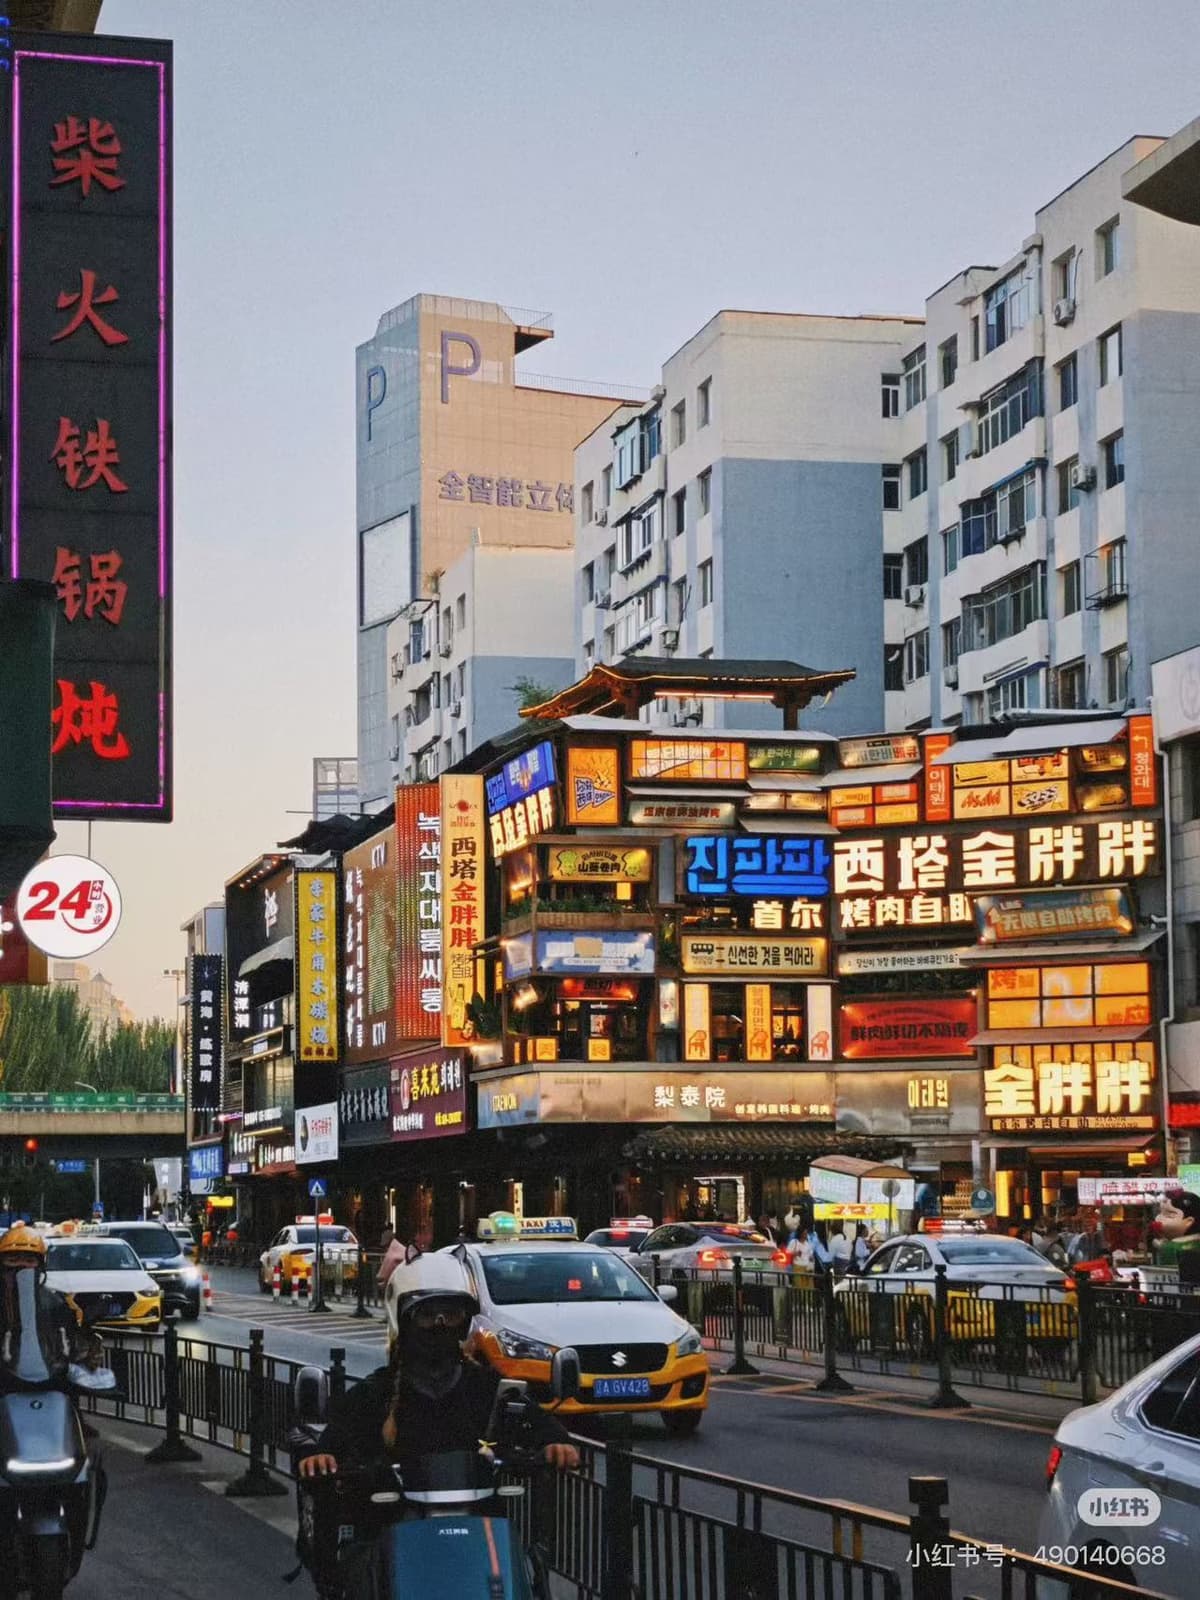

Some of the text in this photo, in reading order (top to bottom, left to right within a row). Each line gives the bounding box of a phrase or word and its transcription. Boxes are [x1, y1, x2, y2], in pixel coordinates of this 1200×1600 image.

[441, 330, 481, 404] P
[48, 115, 130, 759] 柴火铁锅炖
[371, 842, 386, 870] KTV
[832, 820, 1155, 893] 西塔金胖胖
[23, 880, 92, 921] 24
[450, 837, 478, 949] 西塔金胖胖
[753, 898, 823, 929] 首尔
[728, 946, 758, 965] 신선한
[761, 946, 781, 966] 것을
[784, 946, 814, 966] 먹어라
[372, 1021, 386, 1047] KTV
[654, 1085, 726, 1108] 梨泰院
[984, 1061, 1150, 1115] 金胖胖
